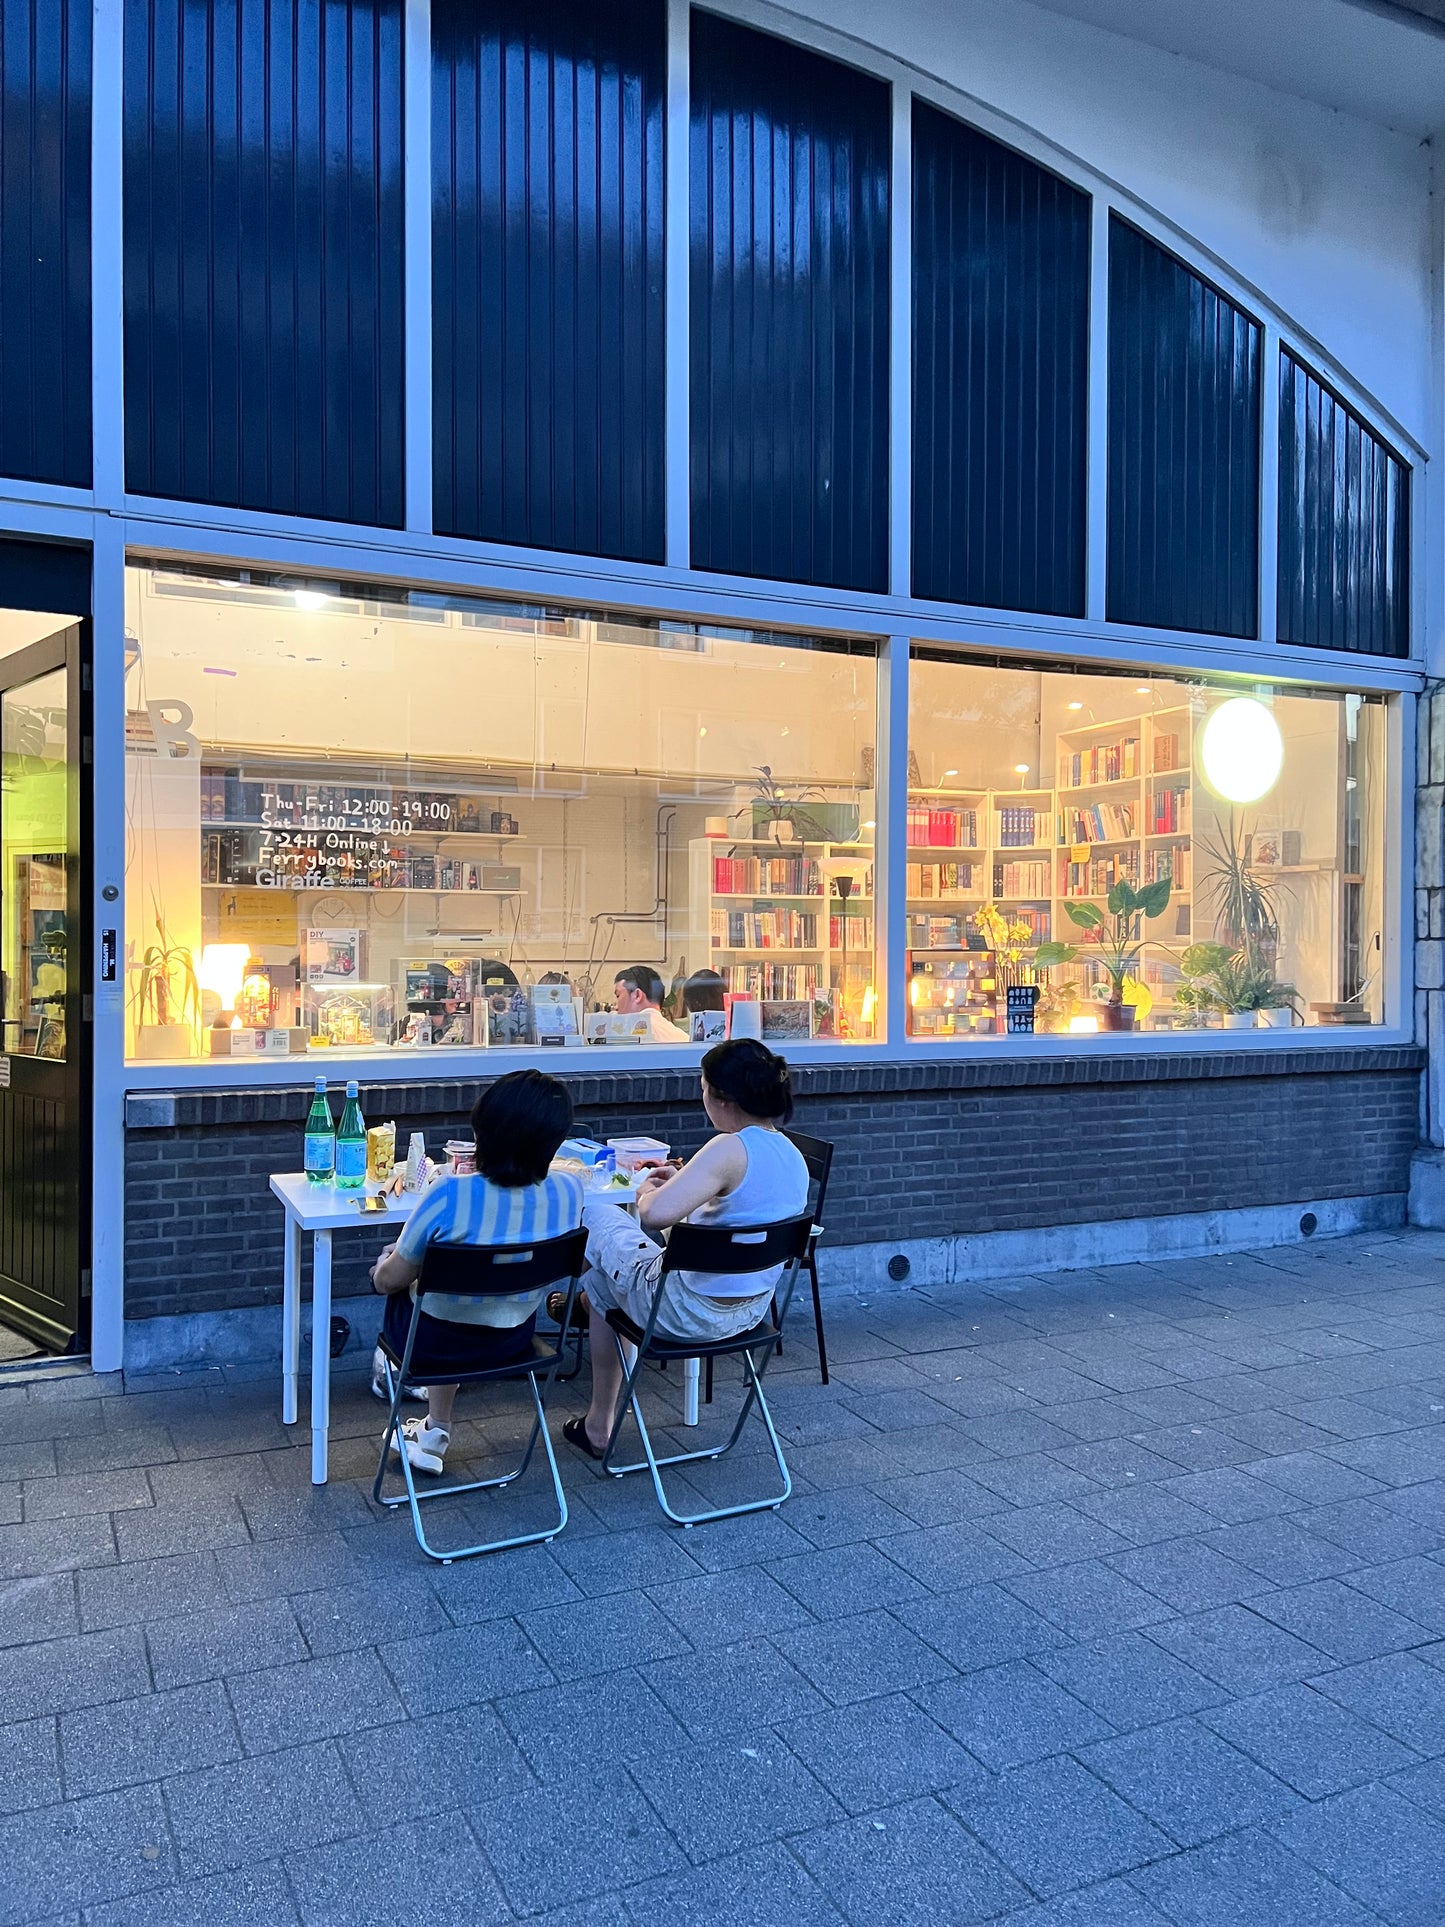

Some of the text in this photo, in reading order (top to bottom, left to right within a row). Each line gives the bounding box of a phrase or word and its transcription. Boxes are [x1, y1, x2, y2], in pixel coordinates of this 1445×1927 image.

[261, 793, 450, 820] Thu-Fri 12:00-19:00
[261, 812, 412, 836] Sat 11:00-18:00
[326, 833, 378, 850] Online
[256, 869, 335, 889] Giraffe
